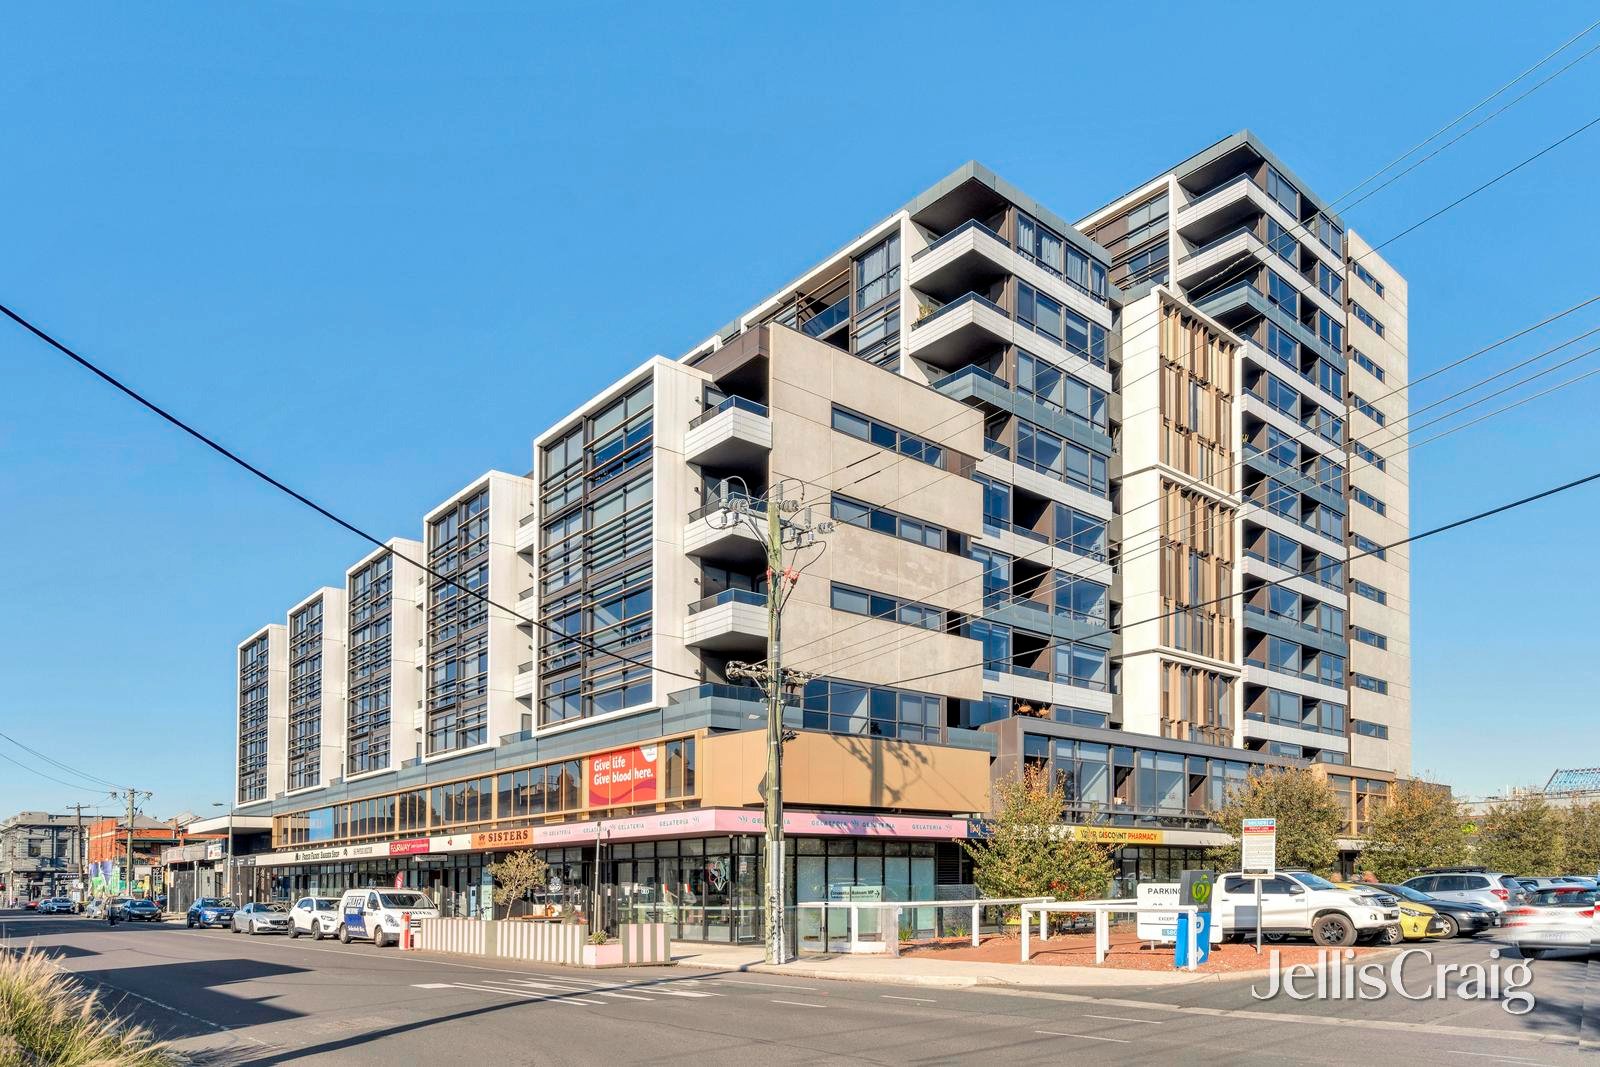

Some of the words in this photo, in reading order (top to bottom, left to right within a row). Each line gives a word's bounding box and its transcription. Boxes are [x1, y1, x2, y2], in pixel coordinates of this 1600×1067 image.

[594, 760, 610, 772] Give
[612, 755, 626, 769] life
[594, 773, 610, 785] Give
[612, 769, 632, 783] blood
[634, 767, 654, 779] here.
[660, 818, 688, 827] GELATERIA
[752, 817, 791, 825] GELIA
[618, 823, 645, 831] GELATERIA
[488, 829, 528, 842] SISTERS
[549, 829, 571, 837] GELATERIA
[1127, 832, 1157, 841] PHARMACY
